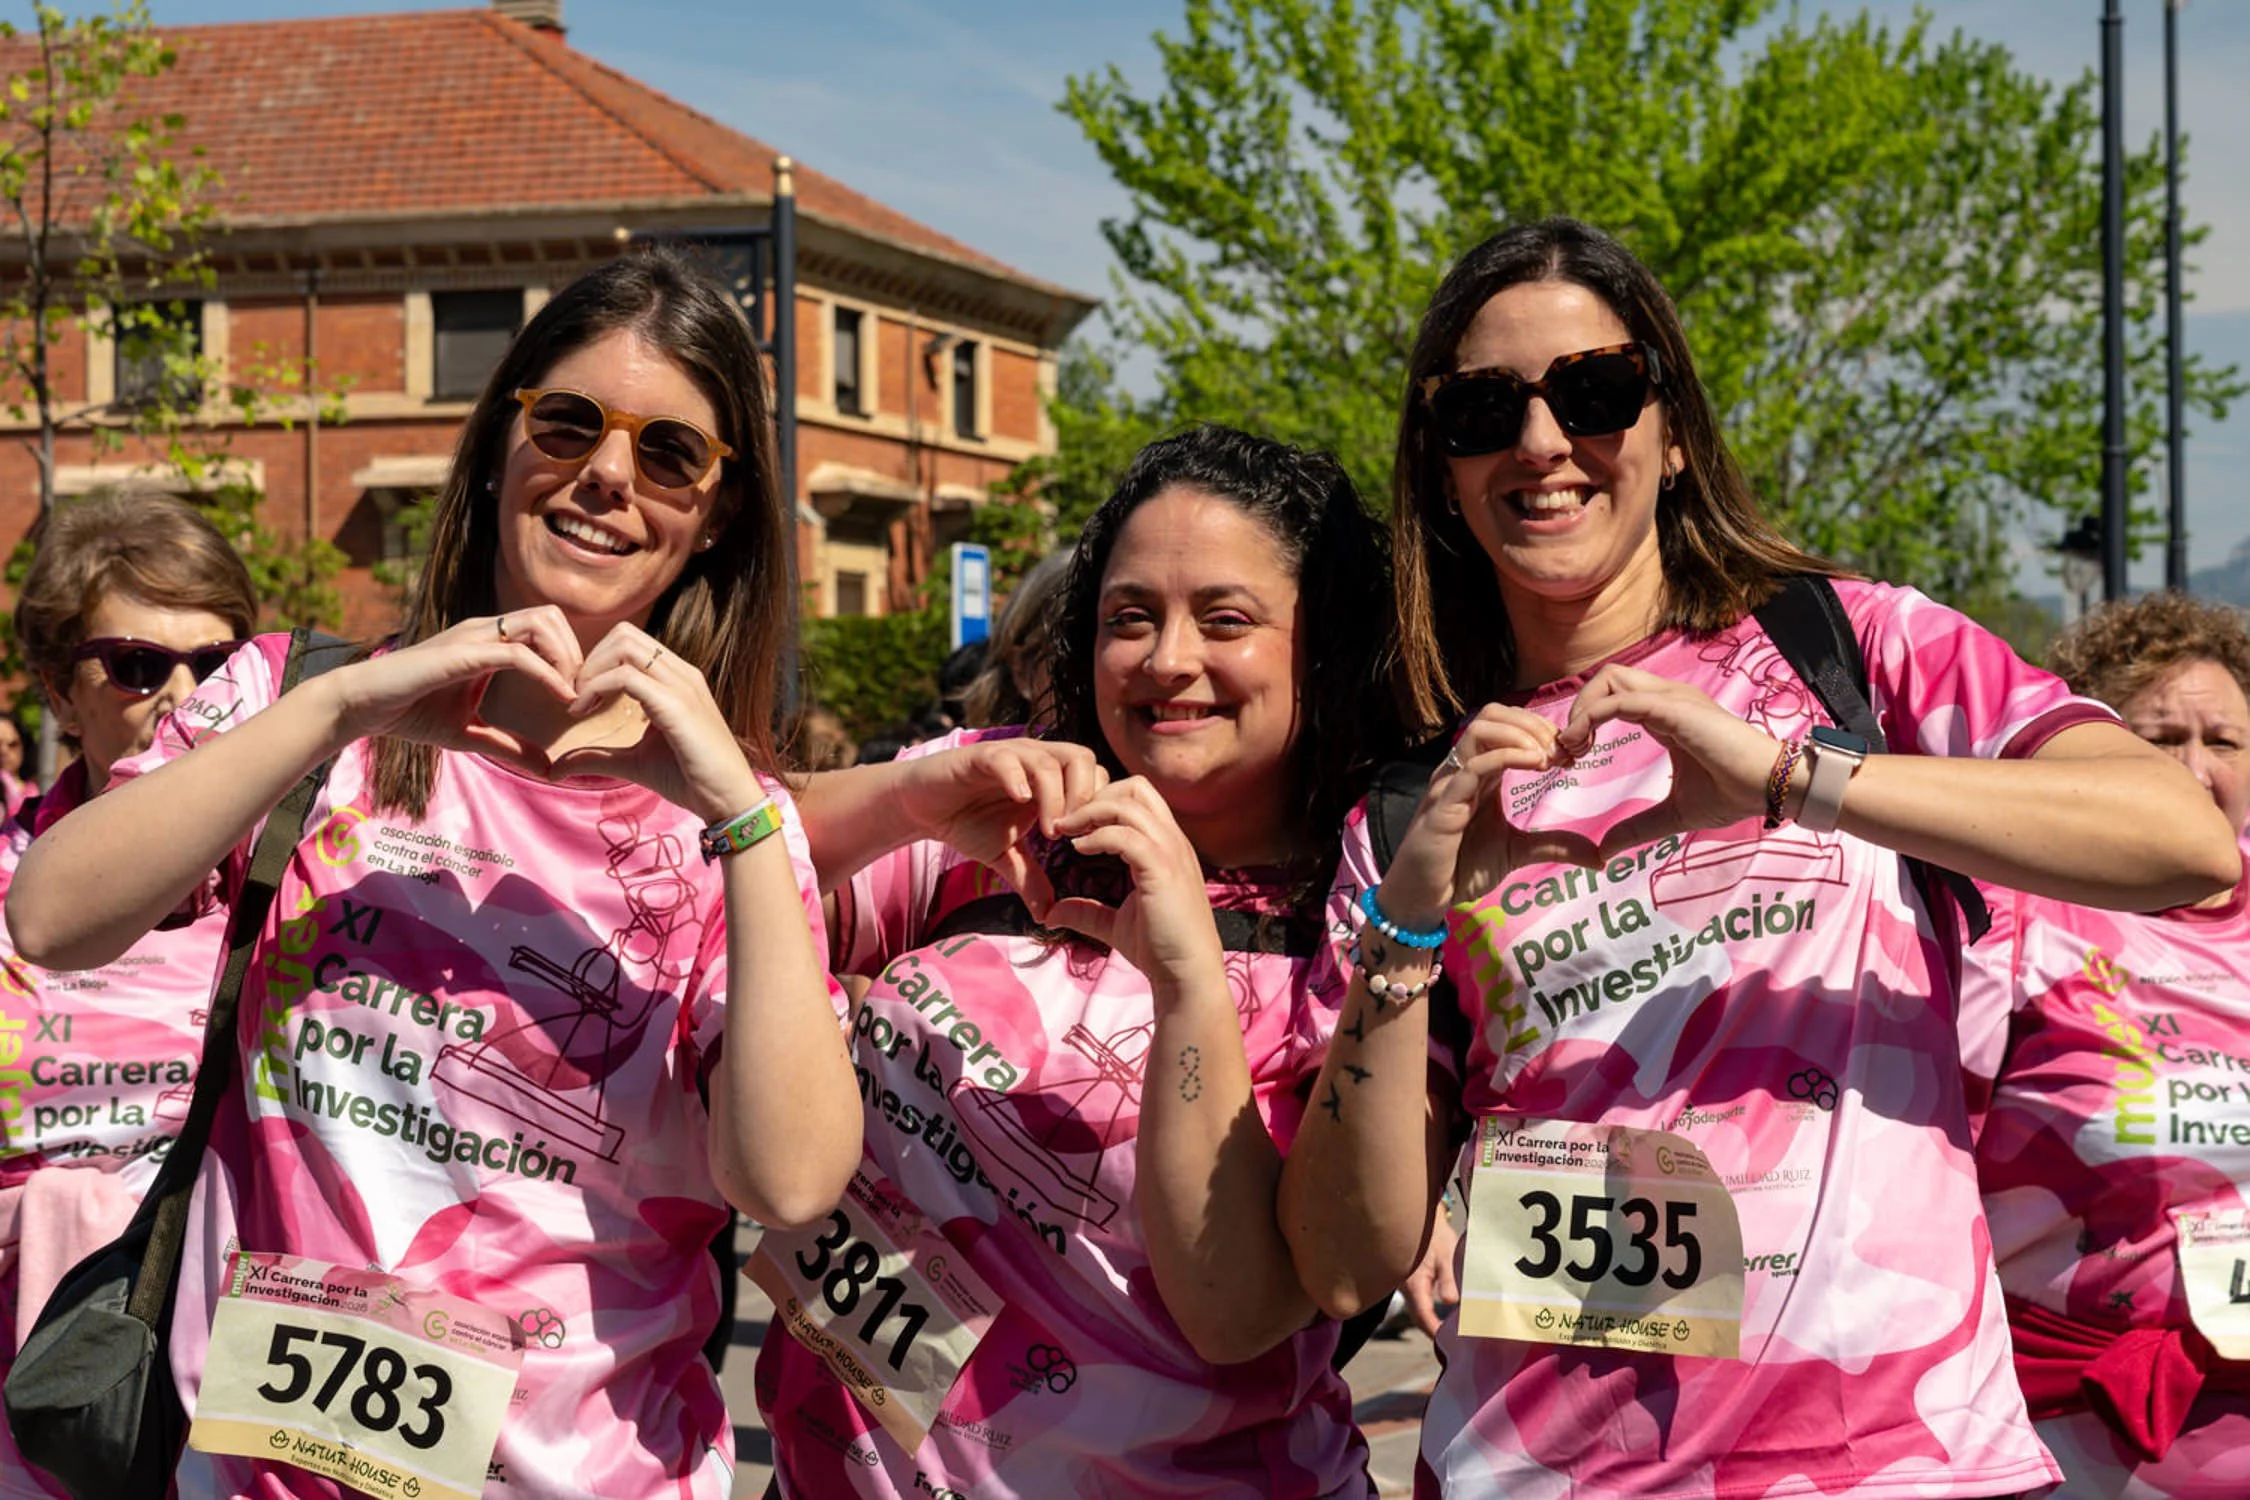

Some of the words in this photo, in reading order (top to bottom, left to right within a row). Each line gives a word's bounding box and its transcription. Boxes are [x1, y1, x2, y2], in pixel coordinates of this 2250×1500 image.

[374, 840, 419, 860] contra
[421, 852, 433, 864] el
[435, 853, 483, 879] cáncer
[380, 825, 451, 850] asociación
[454, 844, 515, 869] española
[367, 853, 384, 867] en
[388, 860, 404, 876] La
[407, 865, 441, 885] Rioja
[1500, 834, 1682, 916] Carrera
[327, 899, 384, 945] XI
[1512, 918, 1590, 988] por
[1598, 896, 1650, 939] la
[313, 953, 486, 1042] Carrera
[33, 1013, 72, 1043] XI
[884, 955, 1018, 1094] Carrera
[2139, 1013, 2182, 1036] XI
[30, 1055, 191, 1087] Carrera
[294, 1017, 374, 1065] por
[381, 1033, 422, 1085] la
[853, 1002, 912, 1060] por
[914, 1042, 946, 1098] la
[2168, 1078, 2231, 1107] por
[34, 1103, 100, 1138] por
[109, 1096, 145, 1126] la
[294, 1066, 577, 1185] Investigación
[1495, 1150, 1583, 1167] investigación
[1497, 1129, 1514, 1146] XI
[1517, 1136, 1567, 1150] Carrera
[1569, 1142, 1594, 1153] por
[1597, 1141, 1609, 1153] la
[1514, 1190, 1702, 1290] 3535
[231, 1256, 249, 1295] mujer
[245, 1283, 340, 1308] investigación
[249, 1265, 268, 1281] XI
[271, 1271, 324, 1291] Carrera
[326, 1283, 351, 1296] por
[354, 1286, 368, 1298] la
[796, 1209, 930, 1372] 3811
[1558, 1312, 1617, 1331] NATUR
[1619, 1318, 1670, 1338] HOUSE
[257, 1323, 453, 1450] 5783
[835, 1348, 873, 1389] HOUSE
[292, 1438, 347, 1466] NATUR
[349, 1456, 402, 1488] HOUSE
